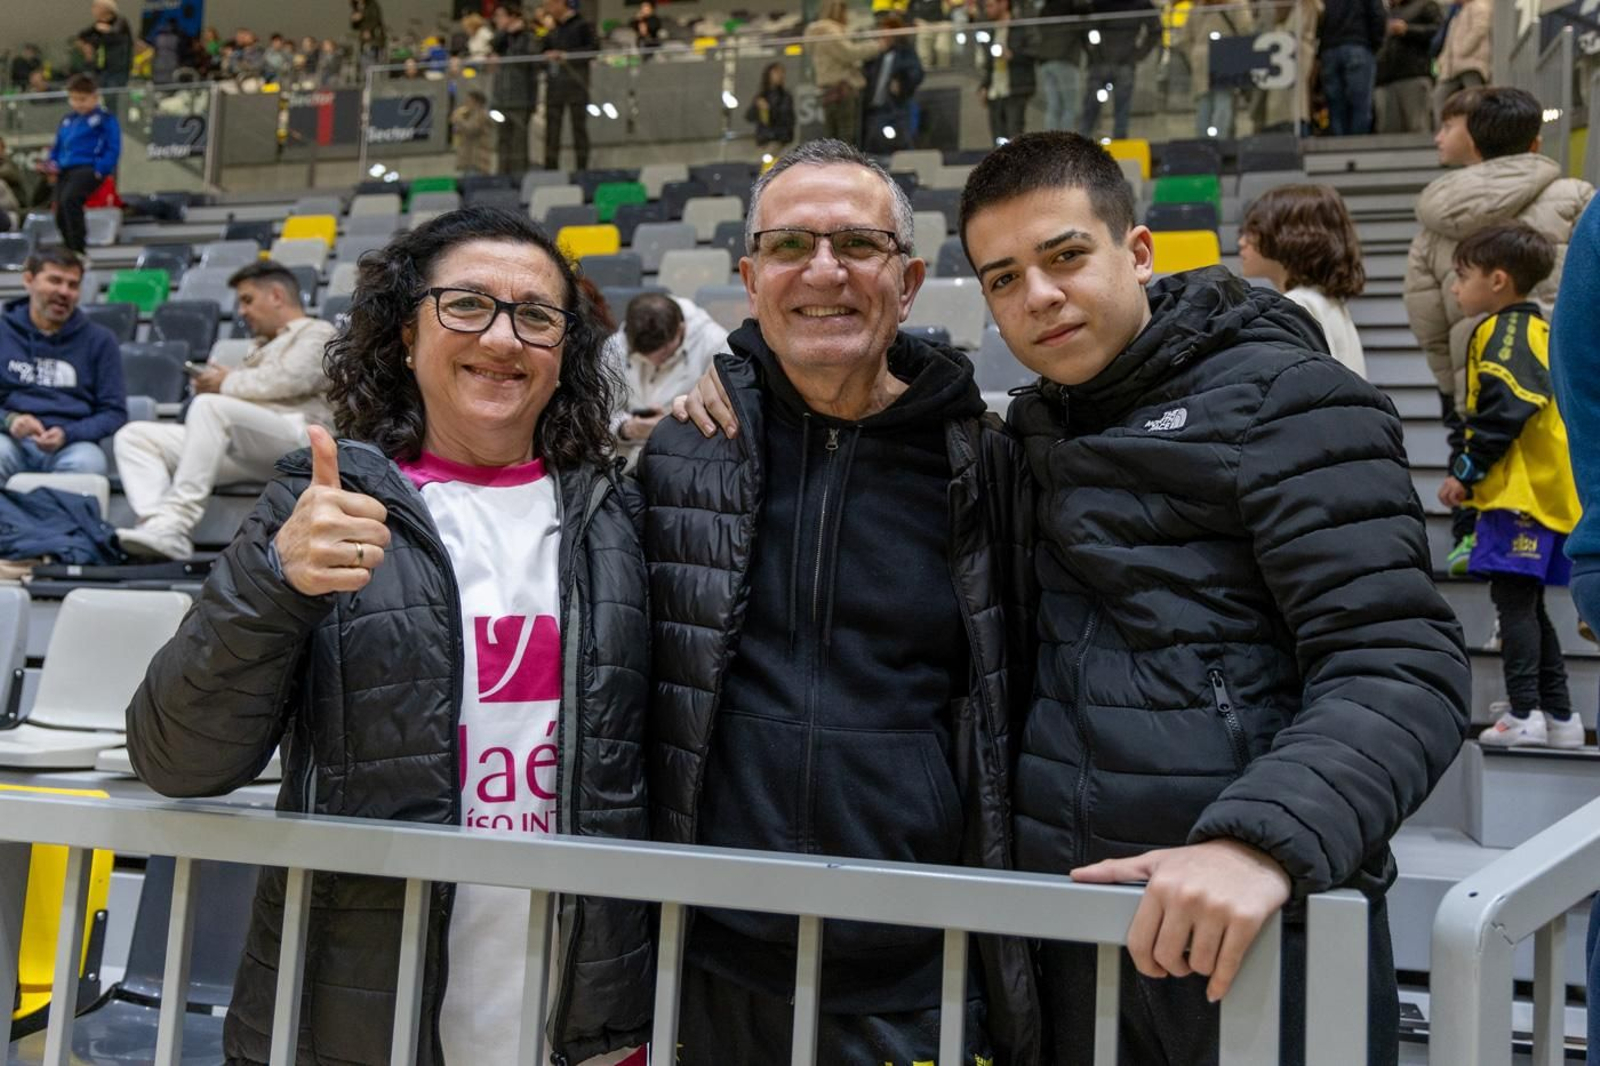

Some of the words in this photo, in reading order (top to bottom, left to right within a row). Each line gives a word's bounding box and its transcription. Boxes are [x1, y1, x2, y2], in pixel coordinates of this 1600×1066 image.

[1252, 31, 1297, 90] 3
[399, 93, 434, 140] 2
[146, 142, 191, 160] Sector
